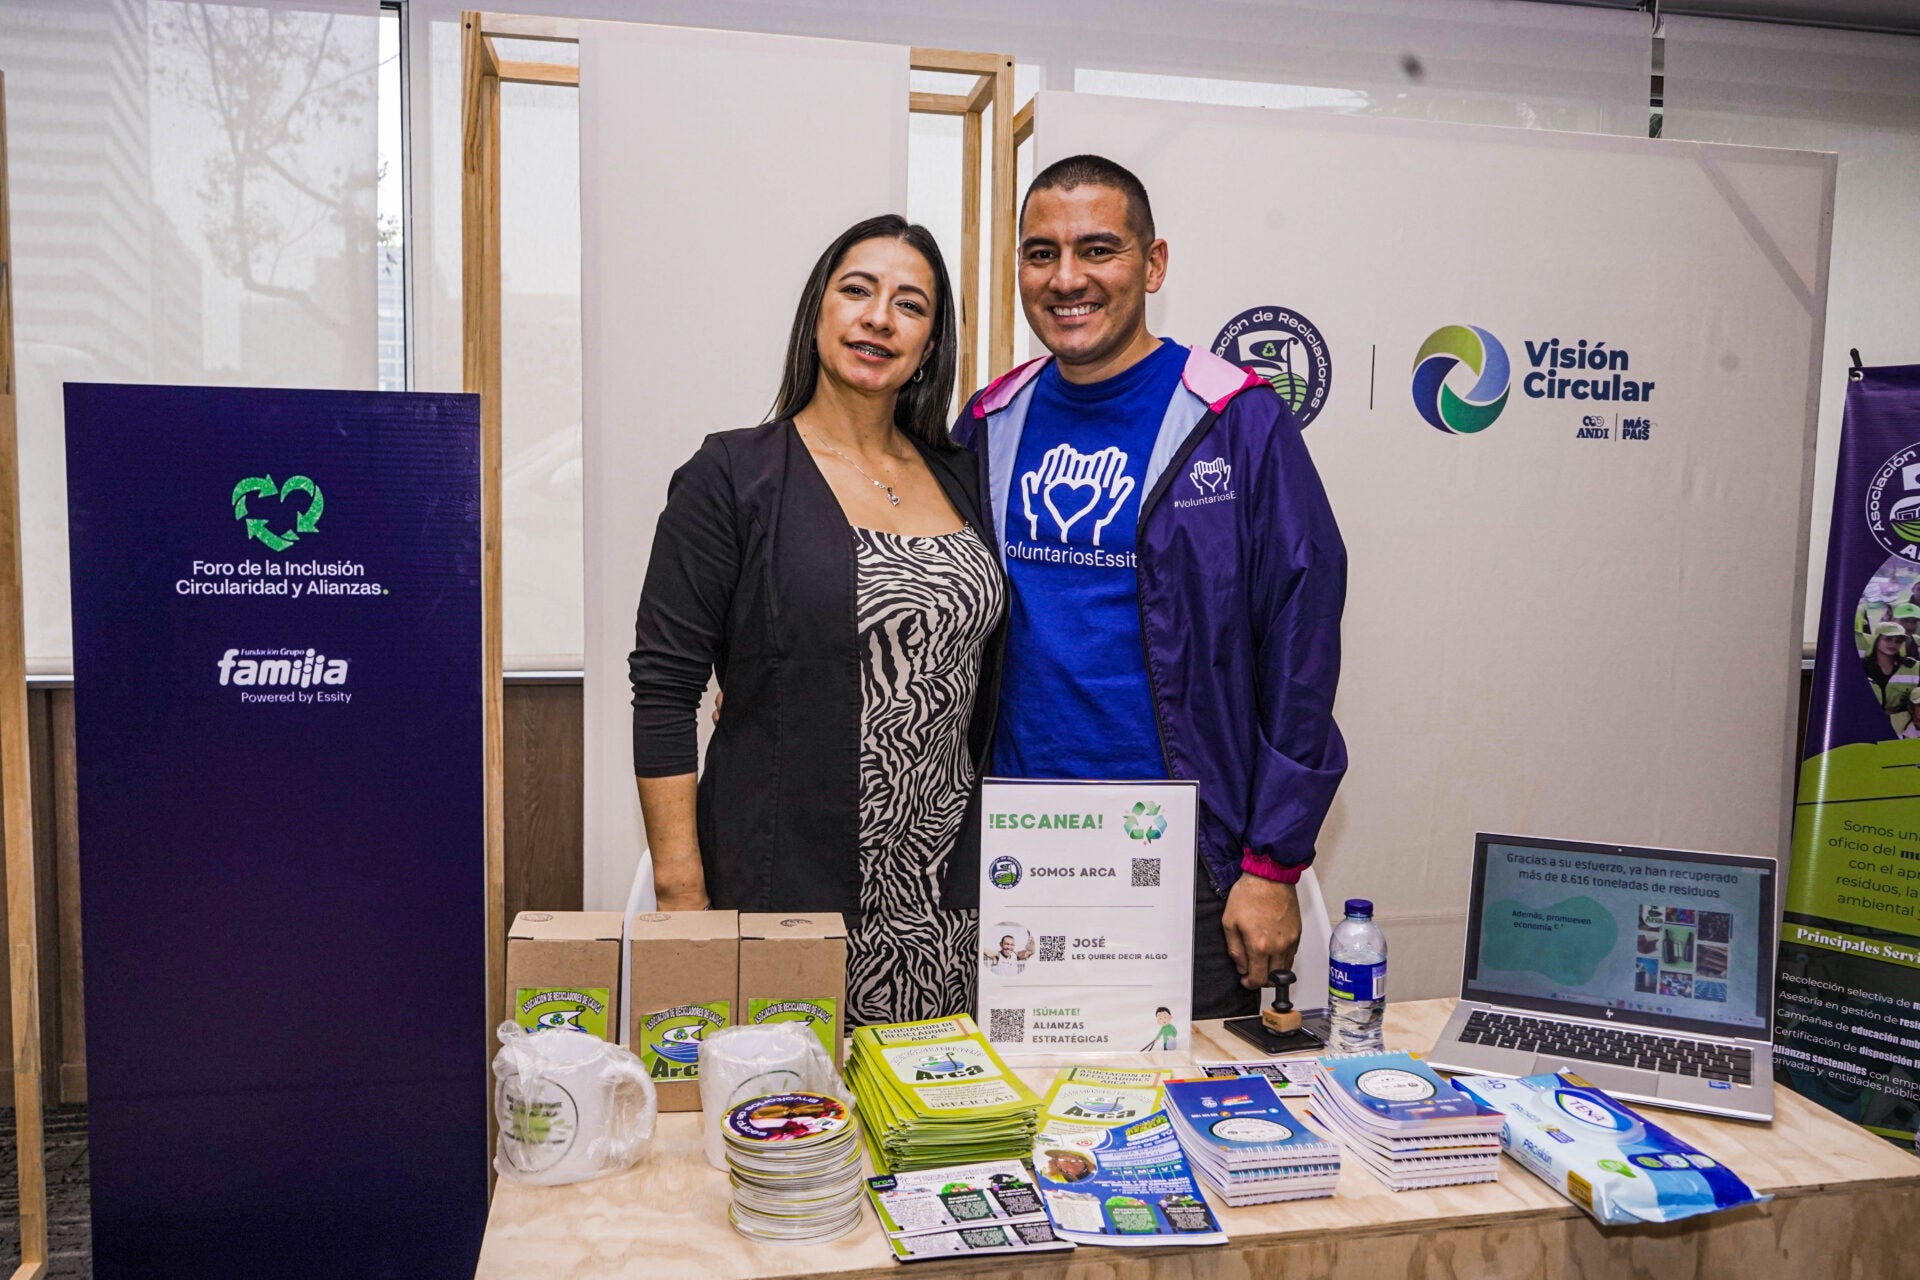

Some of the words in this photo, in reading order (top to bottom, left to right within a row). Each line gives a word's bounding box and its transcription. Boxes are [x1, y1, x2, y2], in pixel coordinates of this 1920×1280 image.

[1215, 317, 1250, 357] ación
[1252, 310, 1274, 323] de
[1278, 312, 1329, 409] Recicladores
[1524, 337, 1629, 371] Visión
[1523, 369, 1655, 402] Circular
[1622, 416, 1651, 430] MÁS
[1576, 427, 1610, 440] ANDI
[1173, 490, 1237, 510] #VoluntariosE
[1870, 450, 1917, 532] Asociación
[1004, 541, 1138, 569] oluntariosEssit
[193, 560, 235, 576] Foro
[238, 560, 261, 576] de
[265, 560, 281, 576] la
[285, 560, 365, 577] Inclusión
[175, 579, 289, 596] Circularidad
[292, 584, 303, 598] y
[241, 648, 279, 657] Fundación
[280, 648, 305, 658] Grupo
[241, 692, 295, 703] Powered
[298, 692, 314, 705] by
[317, 691, 352, 704] Essity
[1843, 820, 1895, 838] Somos
[1828, 836, 1869, 853] oficio
[1872, 843, 1896, 856] del
[1030, 867, 1076, 878] SOMOS
[1080, 867, 1117, 878] ARCA
[1506, 853, 1547, 867] Gracias
[1549, 859, 1556, 867] a
[1559, 859, 1572, 869] su
[1574, 859, 1626, 876] esfuerzo,
[1628, 865, 1642, 878] ya
[1645, 865, 1667, 878] han
[1670, 868, 1738, 885] recuperado
[1848, 860, 1876, 872] con
[1880, 864, 1893, 875] el
[1519, 869, 1542, 881] más
[1545, 871, 1558, 883] de
[1560, 873, 1590, 886] 8.616
[1593, 877, 1649, 892] toneladas
[1651, 882, 1666, 894] de
[1668, 884, 1720, 899] residuos
[1836, 874, 1902, 897] residuos,
[1906, 886, 1918, 898] la
[1837, 893, 1915, 917] ambiental
[1546, 914, 1592, 927] promueven
[1072, 936, 1106, 949] JOSÉ
[1796, 927, 1880, 955] Principales
[1883, 945, 1920, 964] Servi
[1071, 953, 1086, 961] LES
[1088, 953, 1116, 962] QUIERE
[1118, 953, 1142, 961] DECIR
[1144, 953, 1168, 961] ALGO
[1329, 965, 1353, 984] STAL
[1781, 972, 1845, 994] Recolección
[1847, 988, 1894, 1005] selectiva
[1896, 998, 1911, 1009] de
[1778, 990, 1823, 1008] Asesoría
[1825, 1001, 1839, 1011] en
[1841, 1003, 1881, 1021] gestión
[1883, 1014, 1898, 1025] de
[1032, 1021, 1085, 1030] ALIANZAS
[1776, 1008, 1833, 1029] Campañas
[1835, 1021, 1850, 1032] de
[1851, 1025, 1900, 1045] educación
[1900, 1037, 1920, 1050] amb
[1032, 1033, 1109, 1044] ESTRATÉGICAS
[1774, 1026, 1841, 1049] Certificación
[1843, 1043, 1858, 1054] de
[1859, 1045, 1912, 1067] disposición
[650, 1056, 698, 1078] Arc
[915, 1064, 985, 1081] Arca
[1772, 1043, 1811, 1062] Alianzas
[1812, 1054, 1867, 1076] sostenibles
[1869, 1070, 1890, 1082] con
[1892, 1077, 1920, 1091] emp
[1816, 1067, 1824, 1077] y
[1828, 1071, 1882, 1091] entidades
[1063, 1105, 1136, 1119] Arca
[1569, 1101, 1606, 1122] TENA
